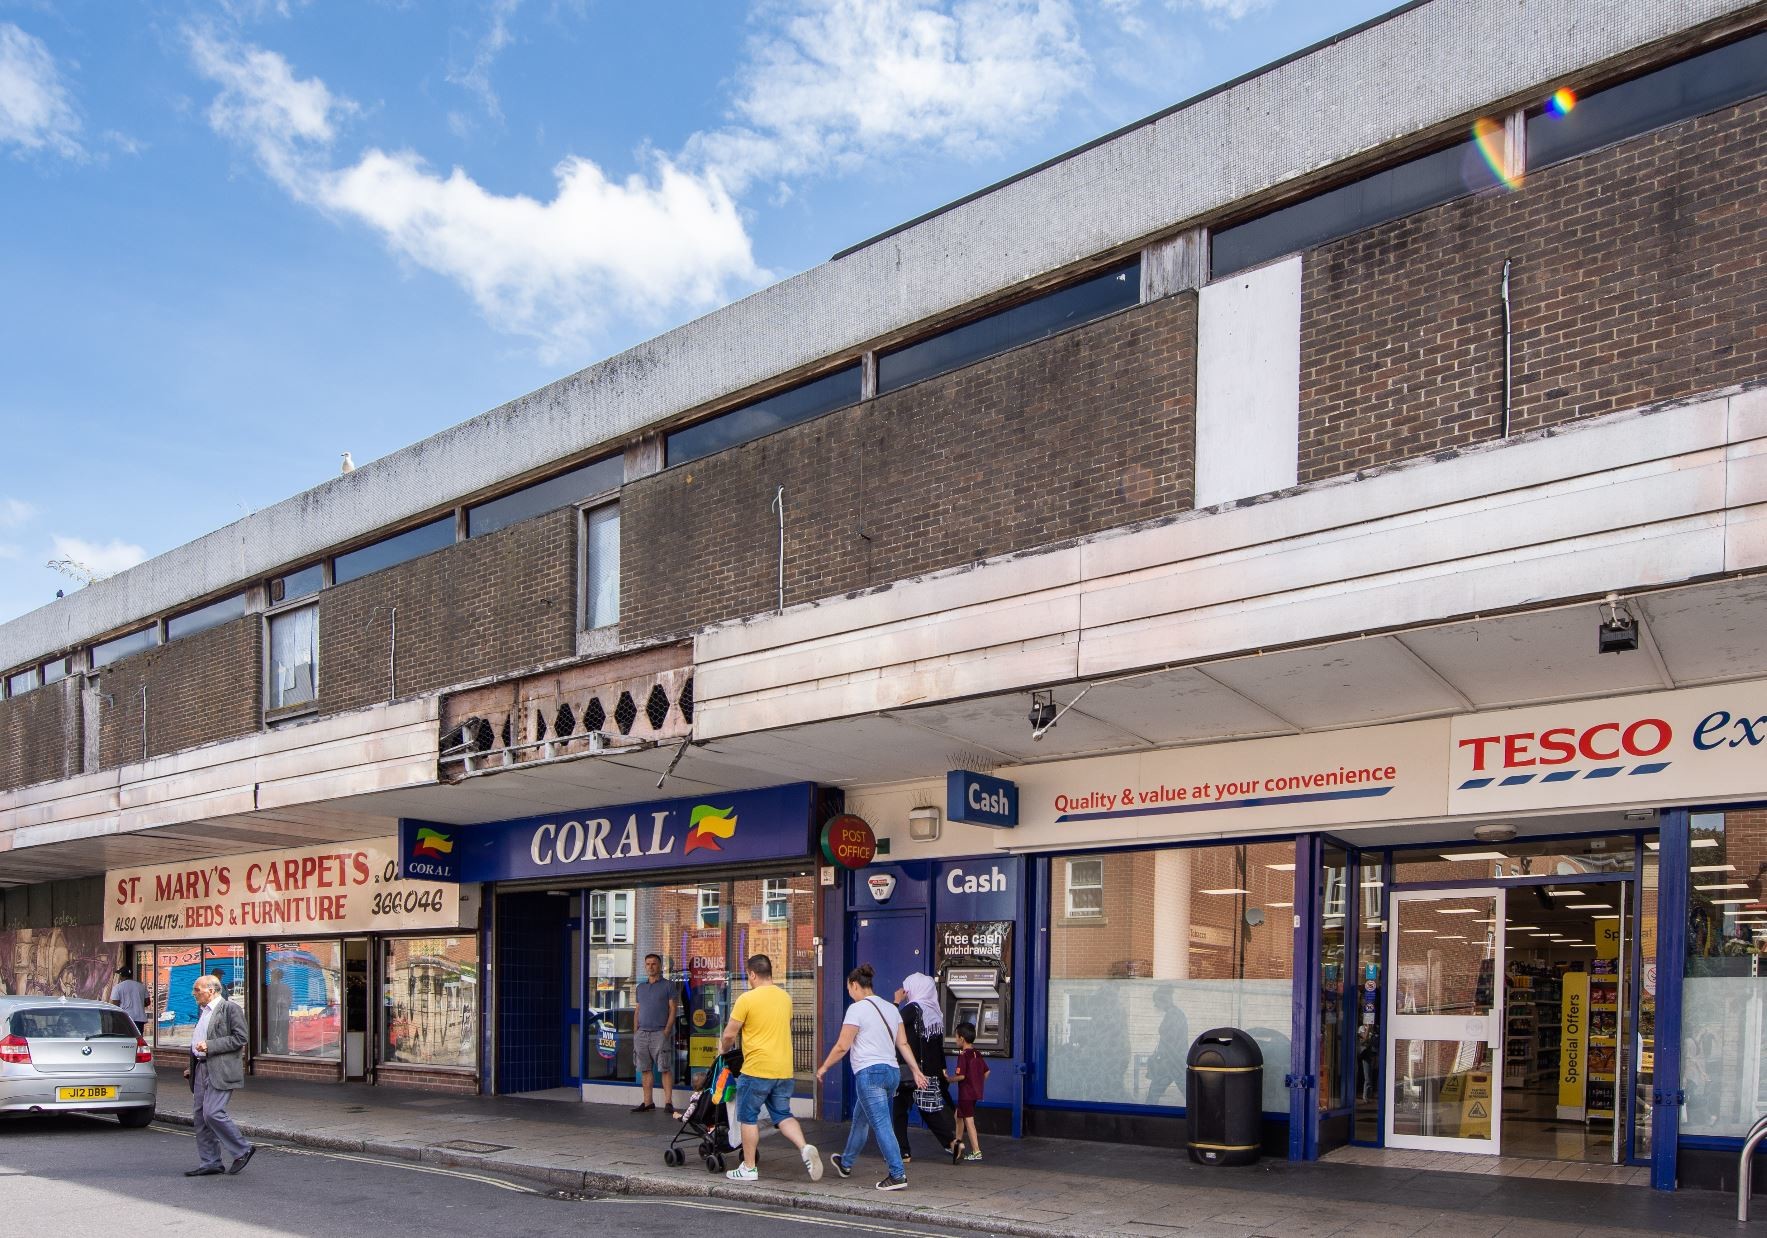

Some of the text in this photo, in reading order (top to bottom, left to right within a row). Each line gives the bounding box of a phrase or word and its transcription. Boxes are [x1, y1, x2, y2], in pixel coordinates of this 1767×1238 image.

[1459, 718, 1673, 771] TESCO
[968, 783, 1009, 816] Cash
[1055, 766, 1396, 812] Quality & value at your convenience
[531, 811, 676, 866] CORAL
[842, 829, 866, 843] POST
[838, 845, 870, 859] OFFICE
[117, 877, 143, 905] ST.
[155, 865, 231, 902] MARY'S
[246, 851, 370, 894] CARPETS
[409, 862, 452, 877] CORAL
[947, 866, 1007, 894] Cash
[115, 917, 137, 932] ALSO
[185, 904, 224, 929] BEDS
[229, 908, 238, 926] &
[241, 894, 348, 926] FURNITURE
[371, 888, 444, 916] 366046
[944, 931, 1002, 945] free cash
[944, 945, 1001, 956] withdrawals
[694, 956, 726, 969] BONUS
[1565, 994, 1580, 1083] Special Offers
[69, 1087, 108, 1098] J12 DBB
